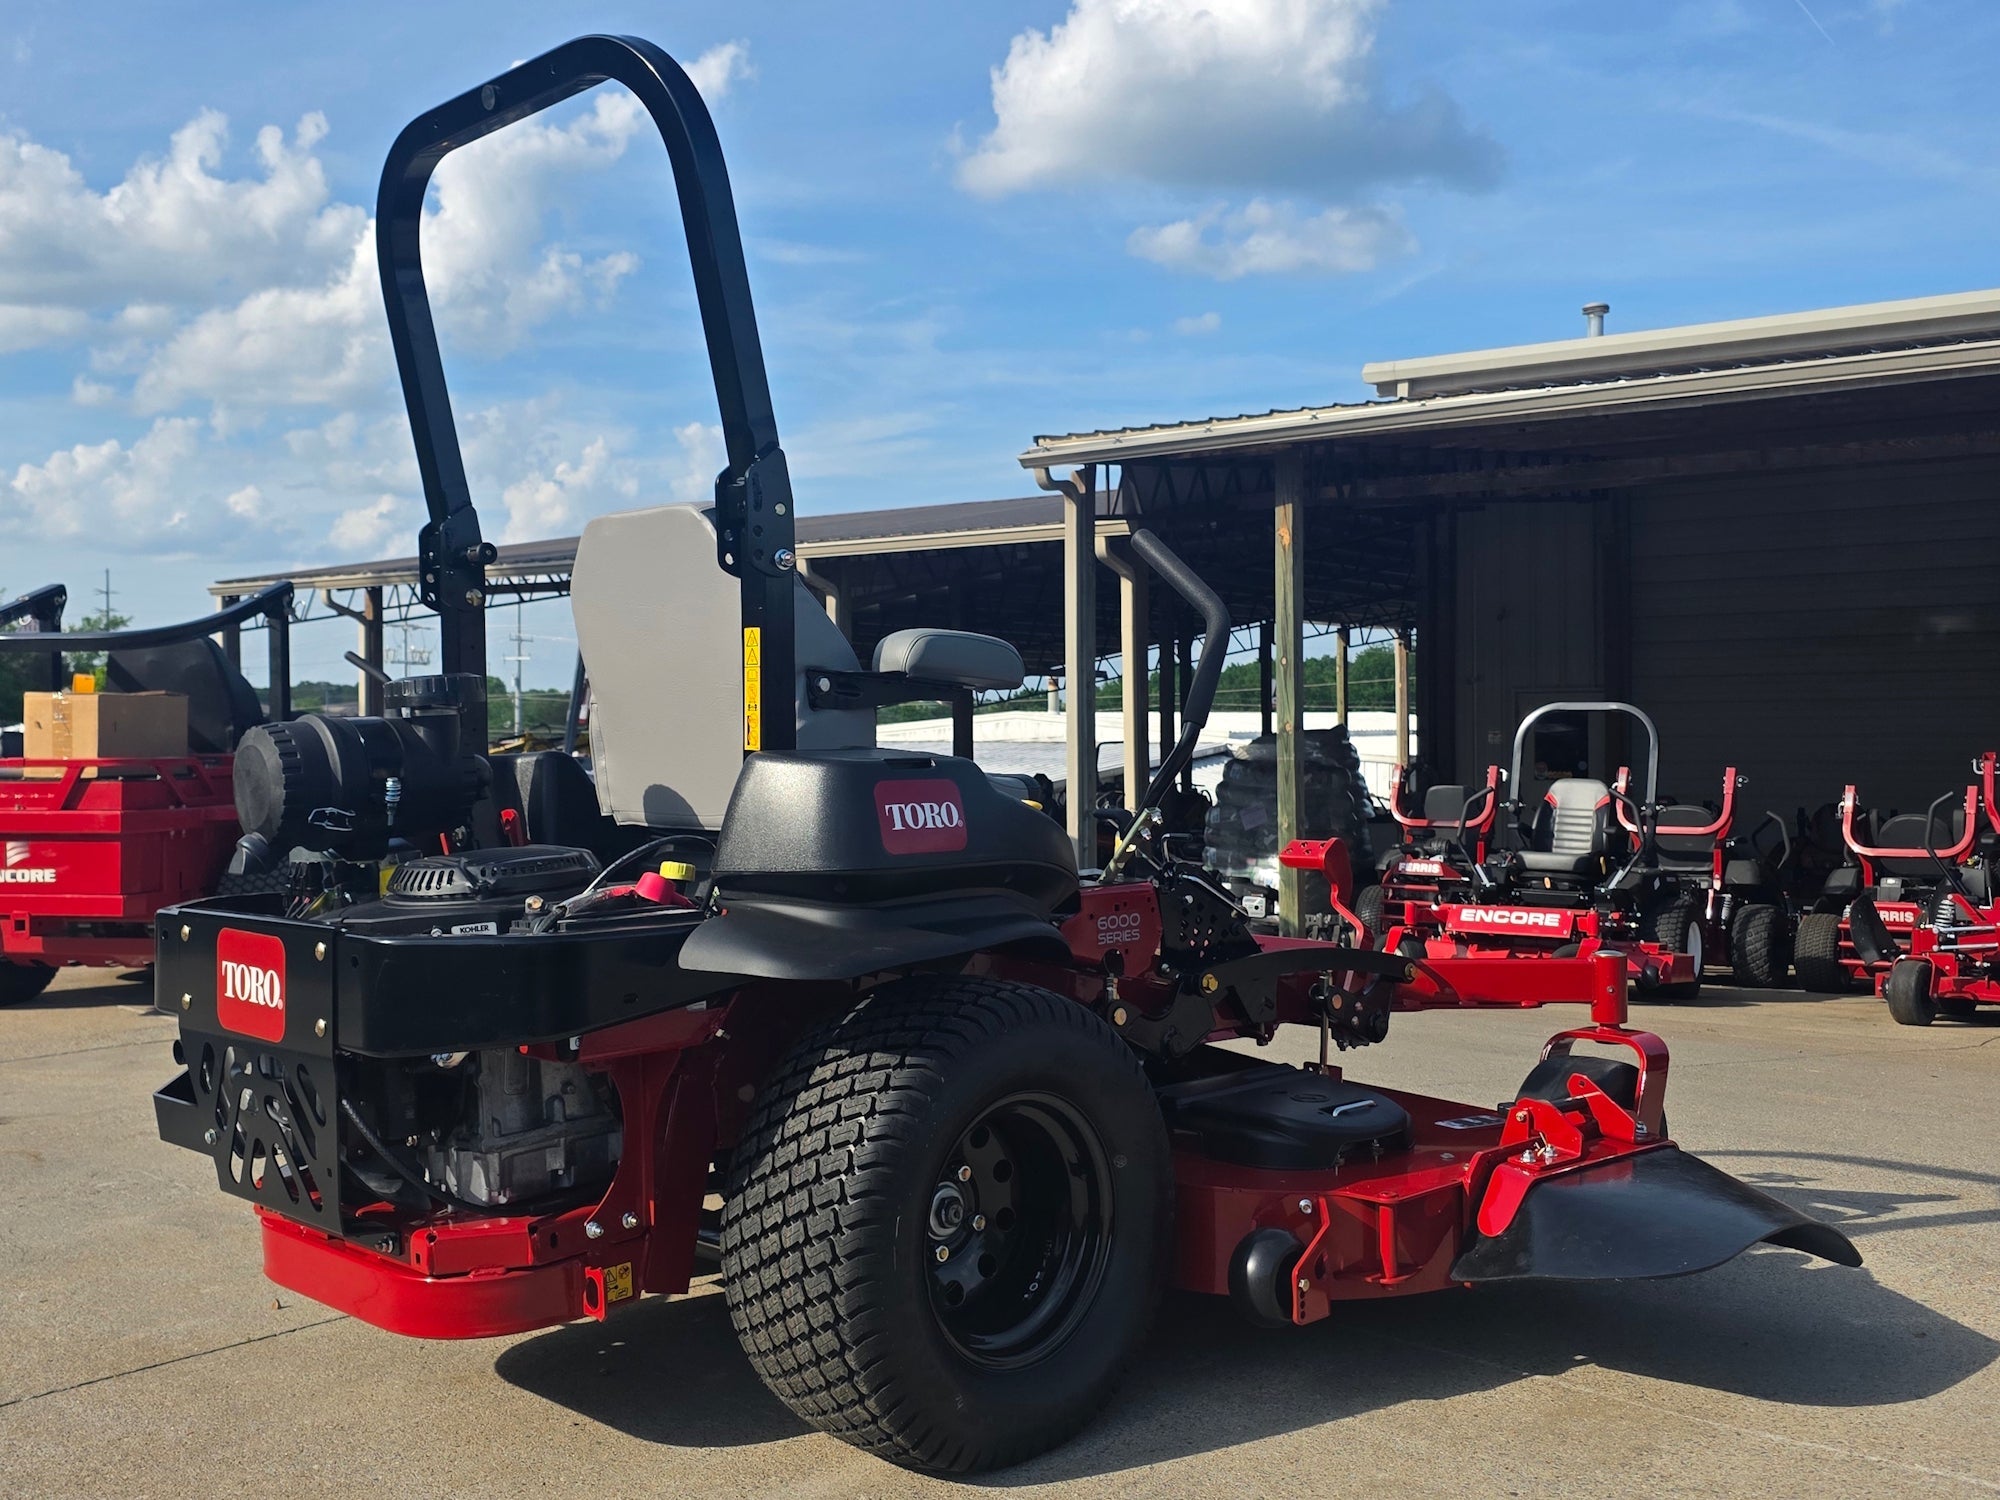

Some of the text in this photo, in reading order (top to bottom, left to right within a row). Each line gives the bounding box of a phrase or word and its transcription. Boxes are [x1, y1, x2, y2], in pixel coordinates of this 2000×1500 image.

[884, 801, 959, 831] TORO
[1398, 862, 1440, 874] FERRIS
[1097, 912, 1140, 930] 6000
[1460, 908, 1561, 927] ENCORE
[1877, 910, 1915, 923] RRIS
[460, 924, 489, 934] KOHLER
[1097, 928, 1140, 945] SERIES
[221, 960, 281, 1008] TORO
